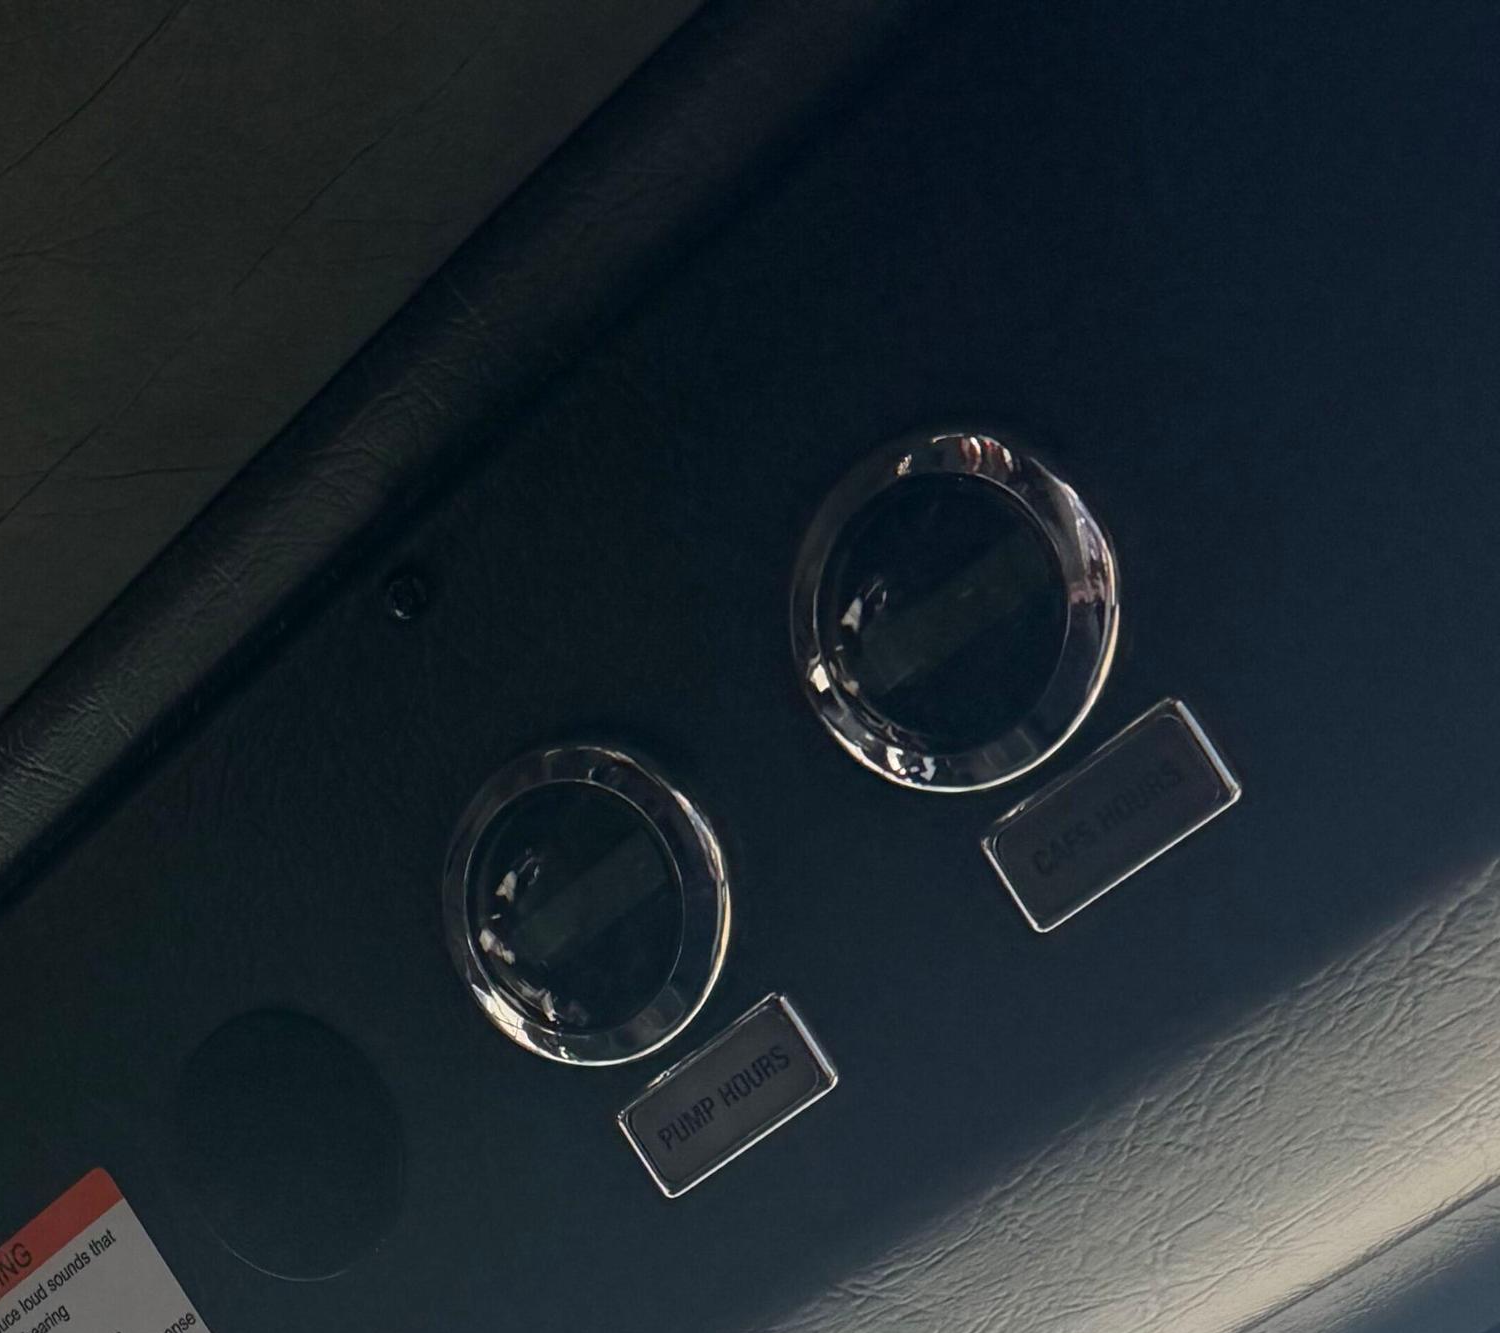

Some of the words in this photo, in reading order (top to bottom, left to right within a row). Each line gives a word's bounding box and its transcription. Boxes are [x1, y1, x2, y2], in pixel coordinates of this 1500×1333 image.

[1094, 759, 1183, 832] HOURS
[658, 1096, 715, 1151] PUMP
[717, 1045, 789, 1108] HOURS
[17, 1283, 48, 1313] loud
[46, 1251, 90, 1291] sounds
[88, 1228, 116, 1256] that
